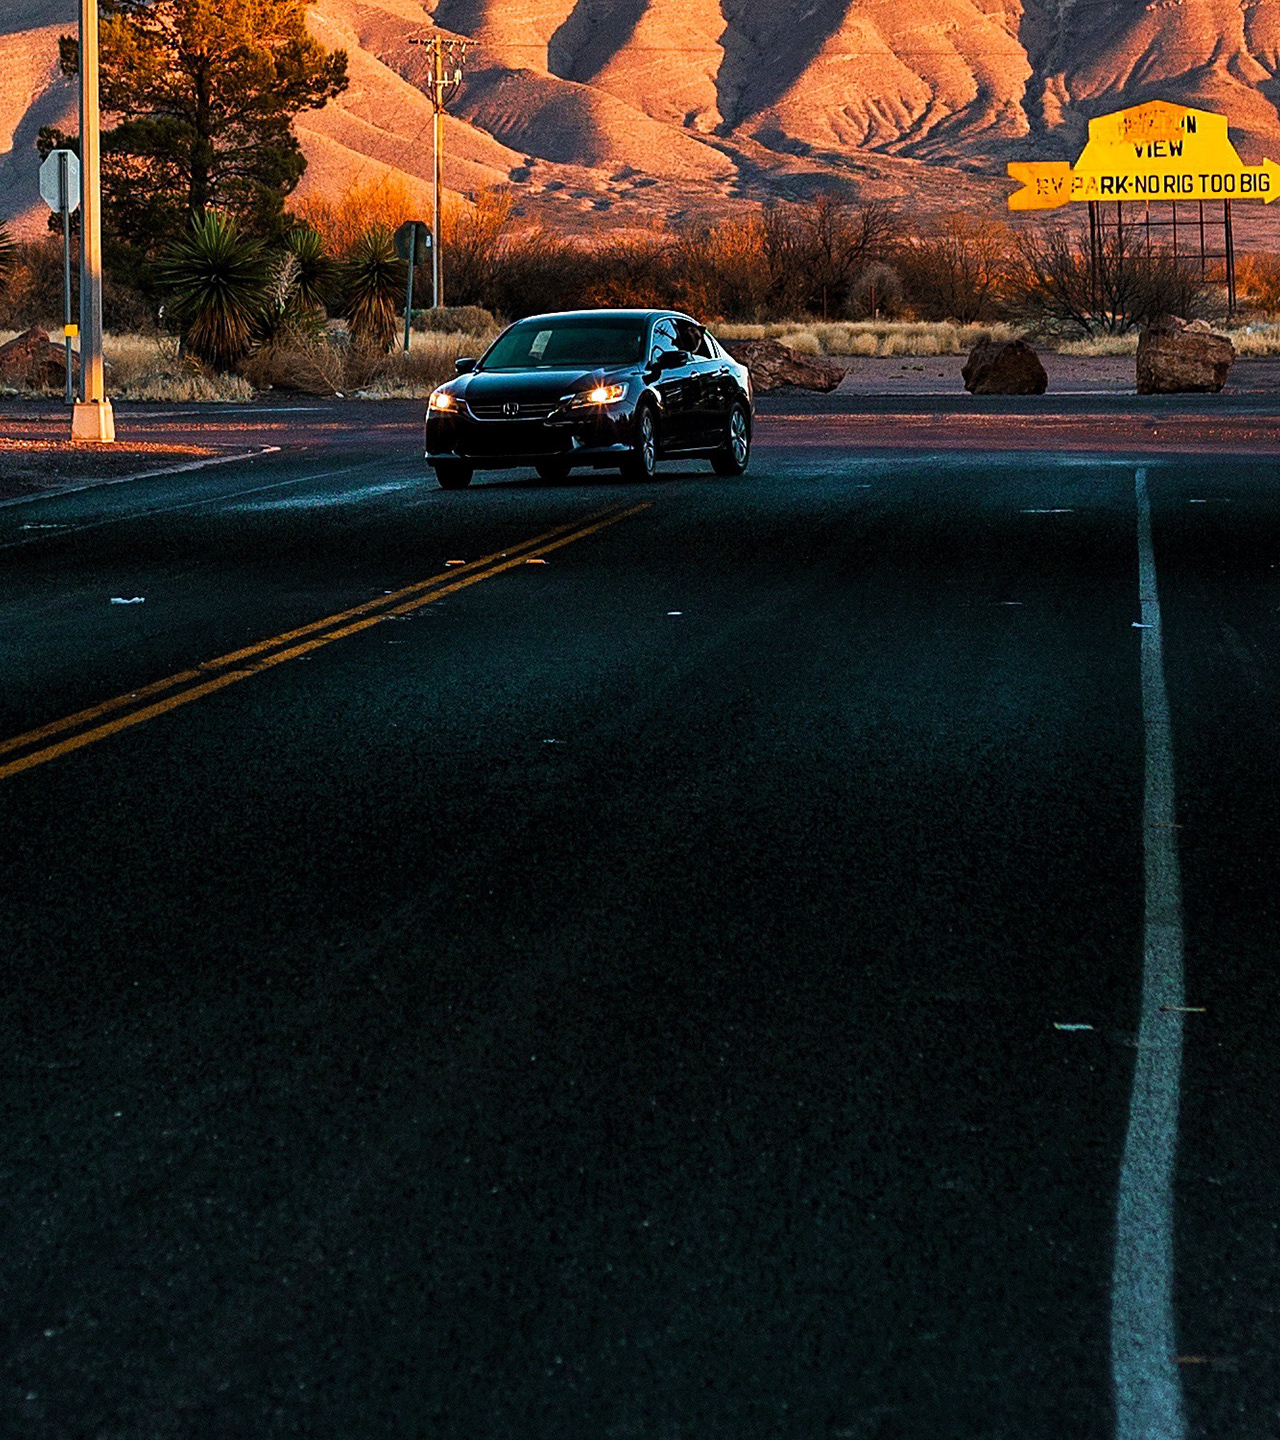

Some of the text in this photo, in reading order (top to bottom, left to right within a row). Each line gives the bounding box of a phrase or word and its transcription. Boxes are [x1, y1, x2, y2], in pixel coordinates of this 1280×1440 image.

[1134, 140, 1183, 158] VIEW
[1163, 174, 1194, 194] RIG
[1201, 173, 1235, 193] TOO
[1240, 172, 1271, 193] BIG
